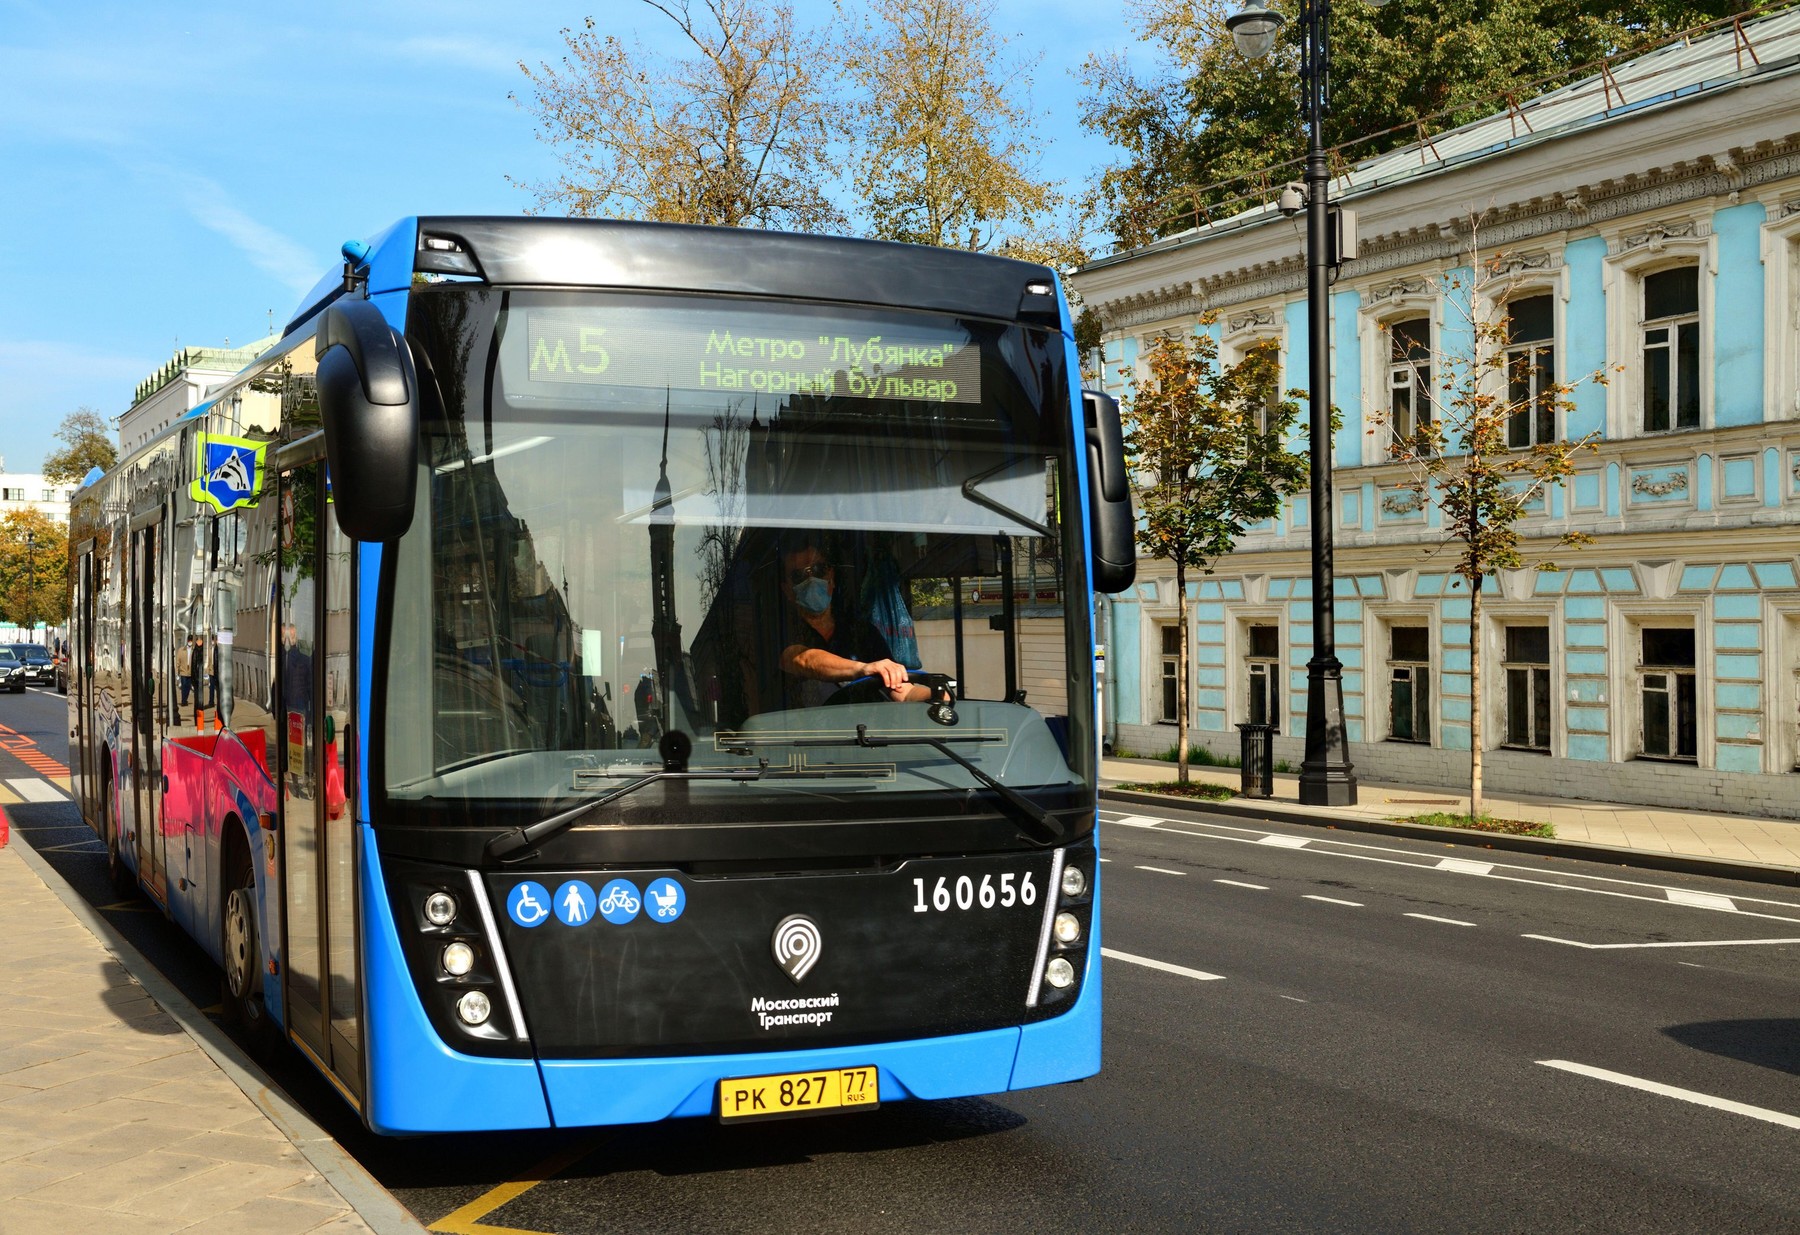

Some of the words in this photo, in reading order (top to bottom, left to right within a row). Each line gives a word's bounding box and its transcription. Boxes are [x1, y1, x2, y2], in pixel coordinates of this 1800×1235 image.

[705, 329, 805, 362] Метро
[818, 335, 954, 372] "Лубянка"
[699, 360, 836, 394] Нагорный
[848, 366, 958, 402] бульвар
[913, 871, 1037, 913] 160656
[751, 993, 840, 1012] Московский
[758, 1012, 833, 1030] Транспорт
[779, 1076, 827, 1107] 827
[843, 1071, 867, 1094] 77
[847, 1093, 866, 1103] RUS
